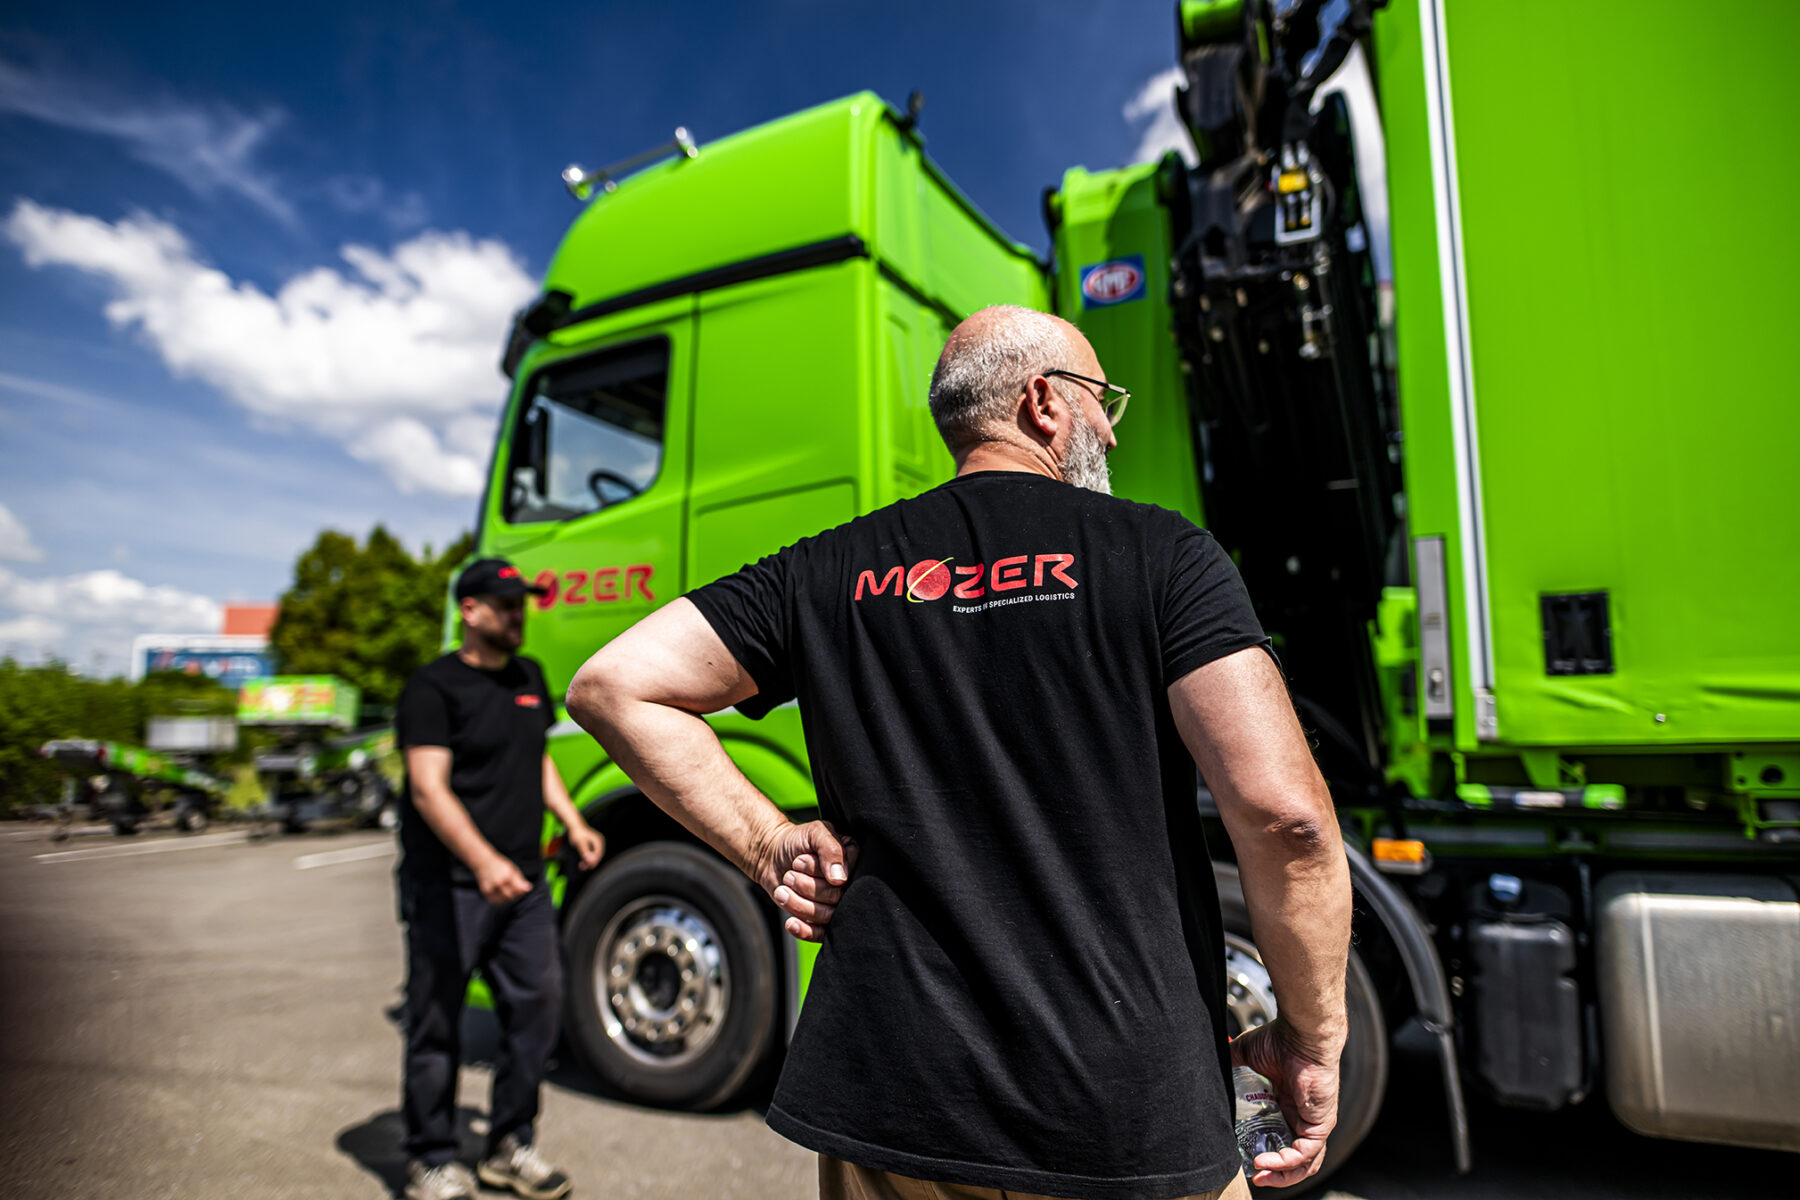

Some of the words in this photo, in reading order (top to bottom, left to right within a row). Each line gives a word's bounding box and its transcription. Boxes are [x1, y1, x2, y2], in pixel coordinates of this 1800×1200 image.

[527, 564, 655, 611] OZER
[854, 553, 1079, 602] MOZER
[952, 604, 982, 614] EXPERTS
[989, 594, 1034, 608] SPECIALIZED
[1035, 592, 1076, 601] LOGISTICS
